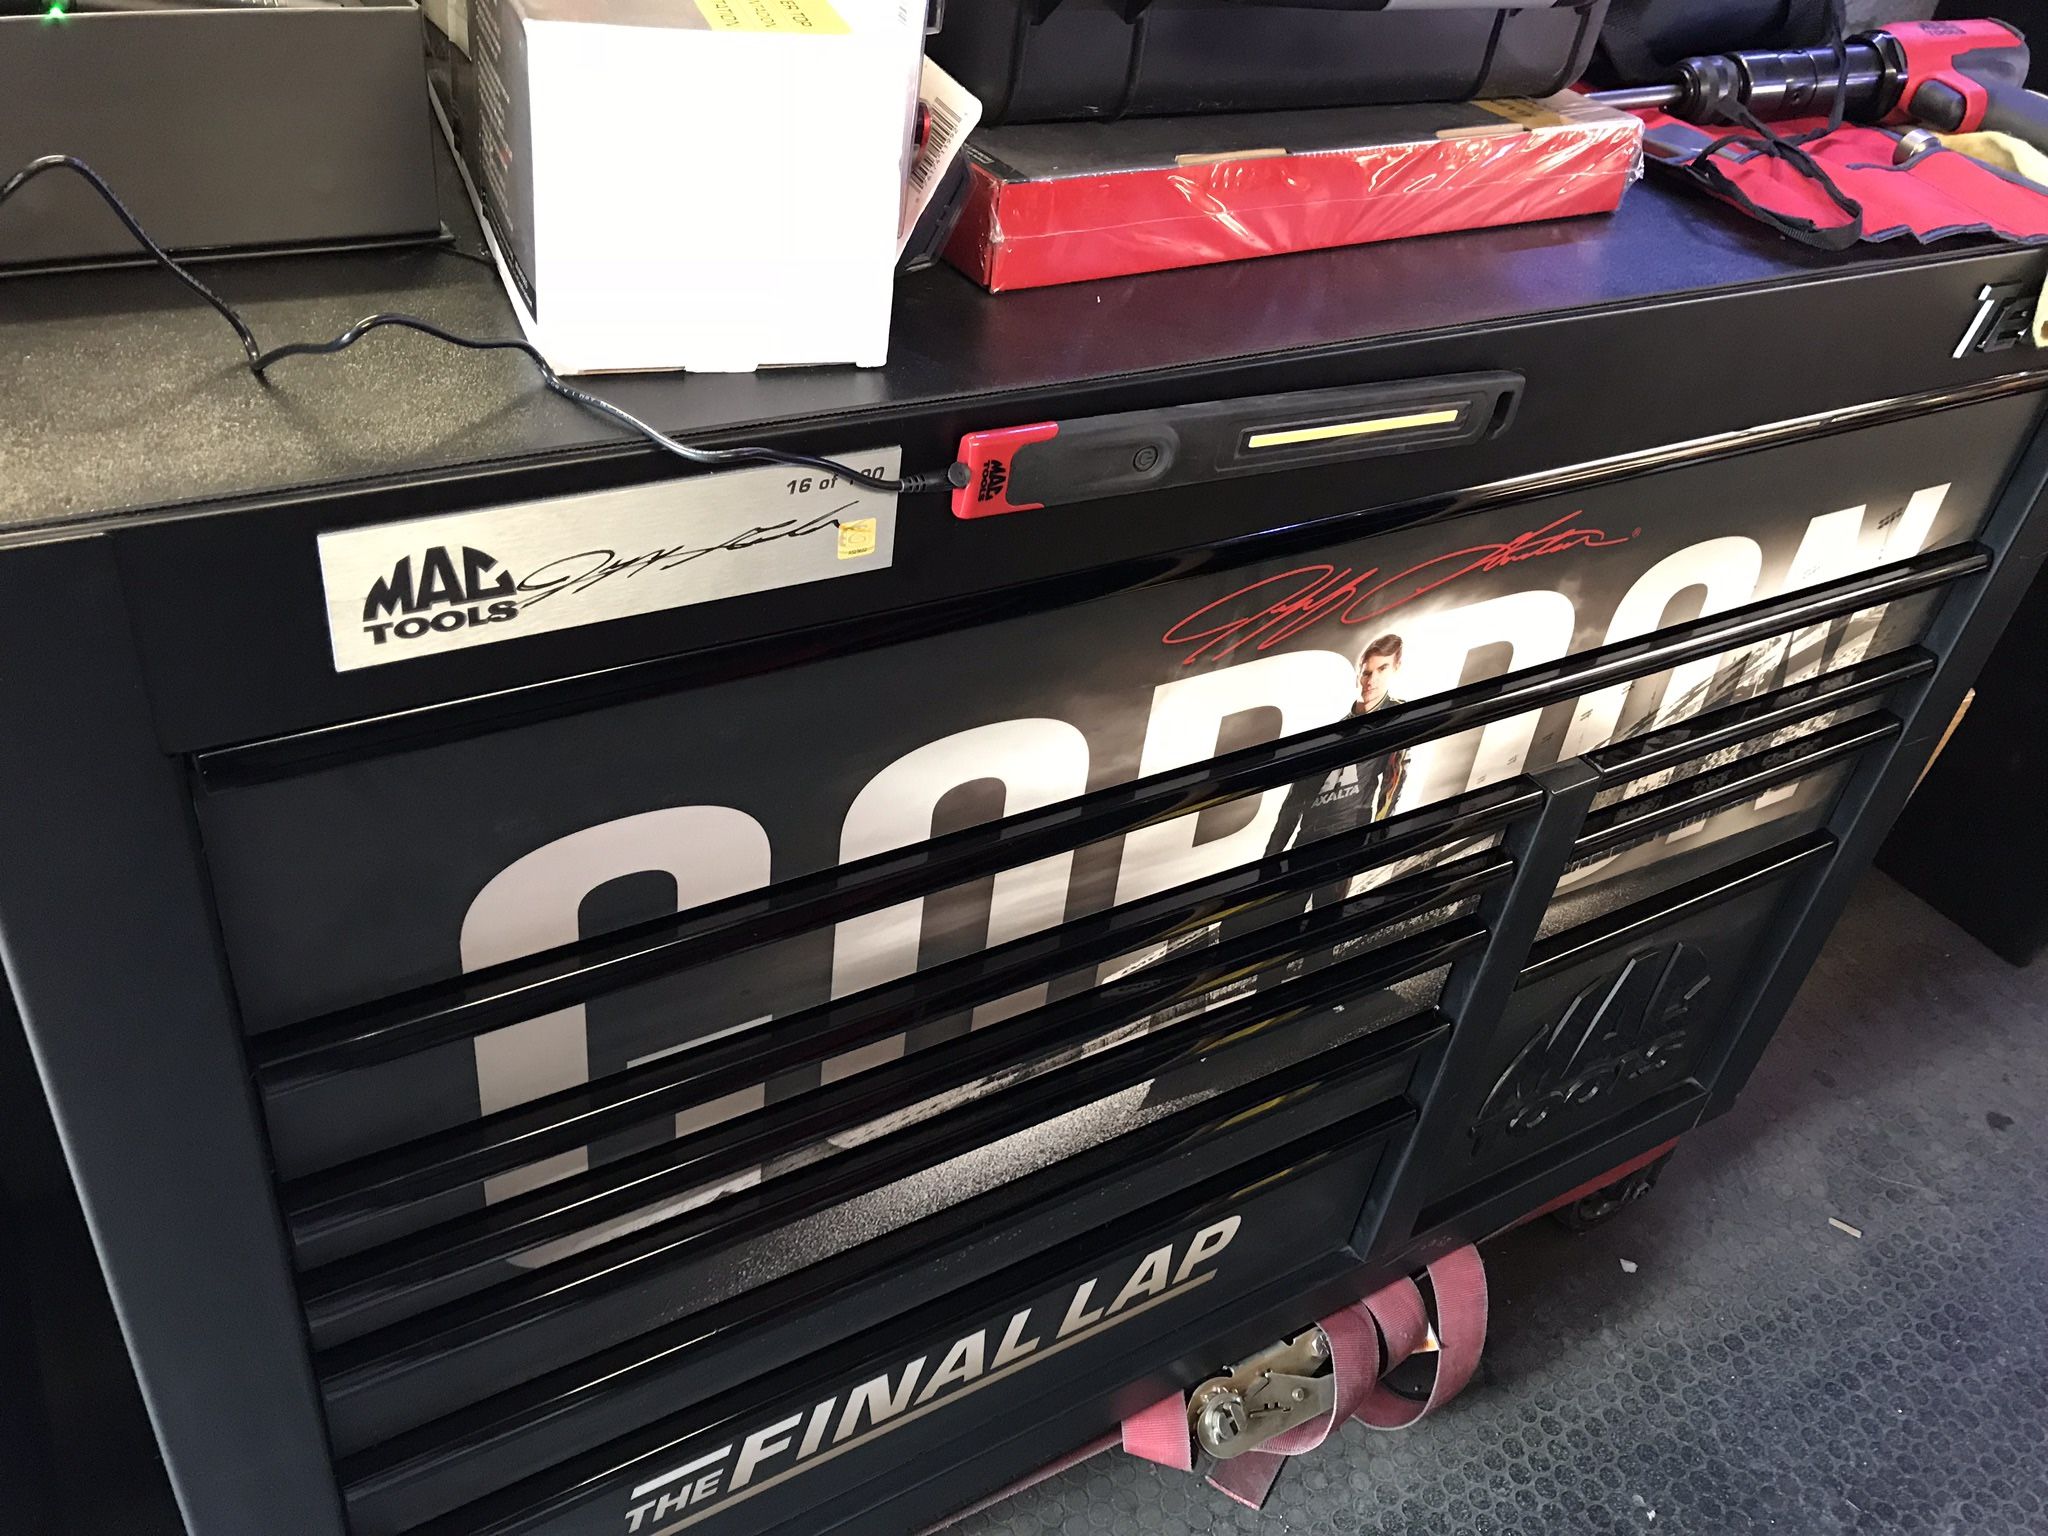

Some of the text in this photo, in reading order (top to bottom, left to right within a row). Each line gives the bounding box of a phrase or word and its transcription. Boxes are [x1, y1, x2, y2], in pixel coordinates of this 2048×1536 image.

[787, 478, 813, 495] 16
[819, 473, 839, 490] of
[977, 459, 990, 502] TOOLS
[984, 459, 1006, 501] MAC
[362, 545, 518, 623] MAC
[362, 600, 519, 646] TOOLS
[1311, 784, 1360, 809] AXALTA
[624, 1214, 1243, 1534] THE FINAL LAP
